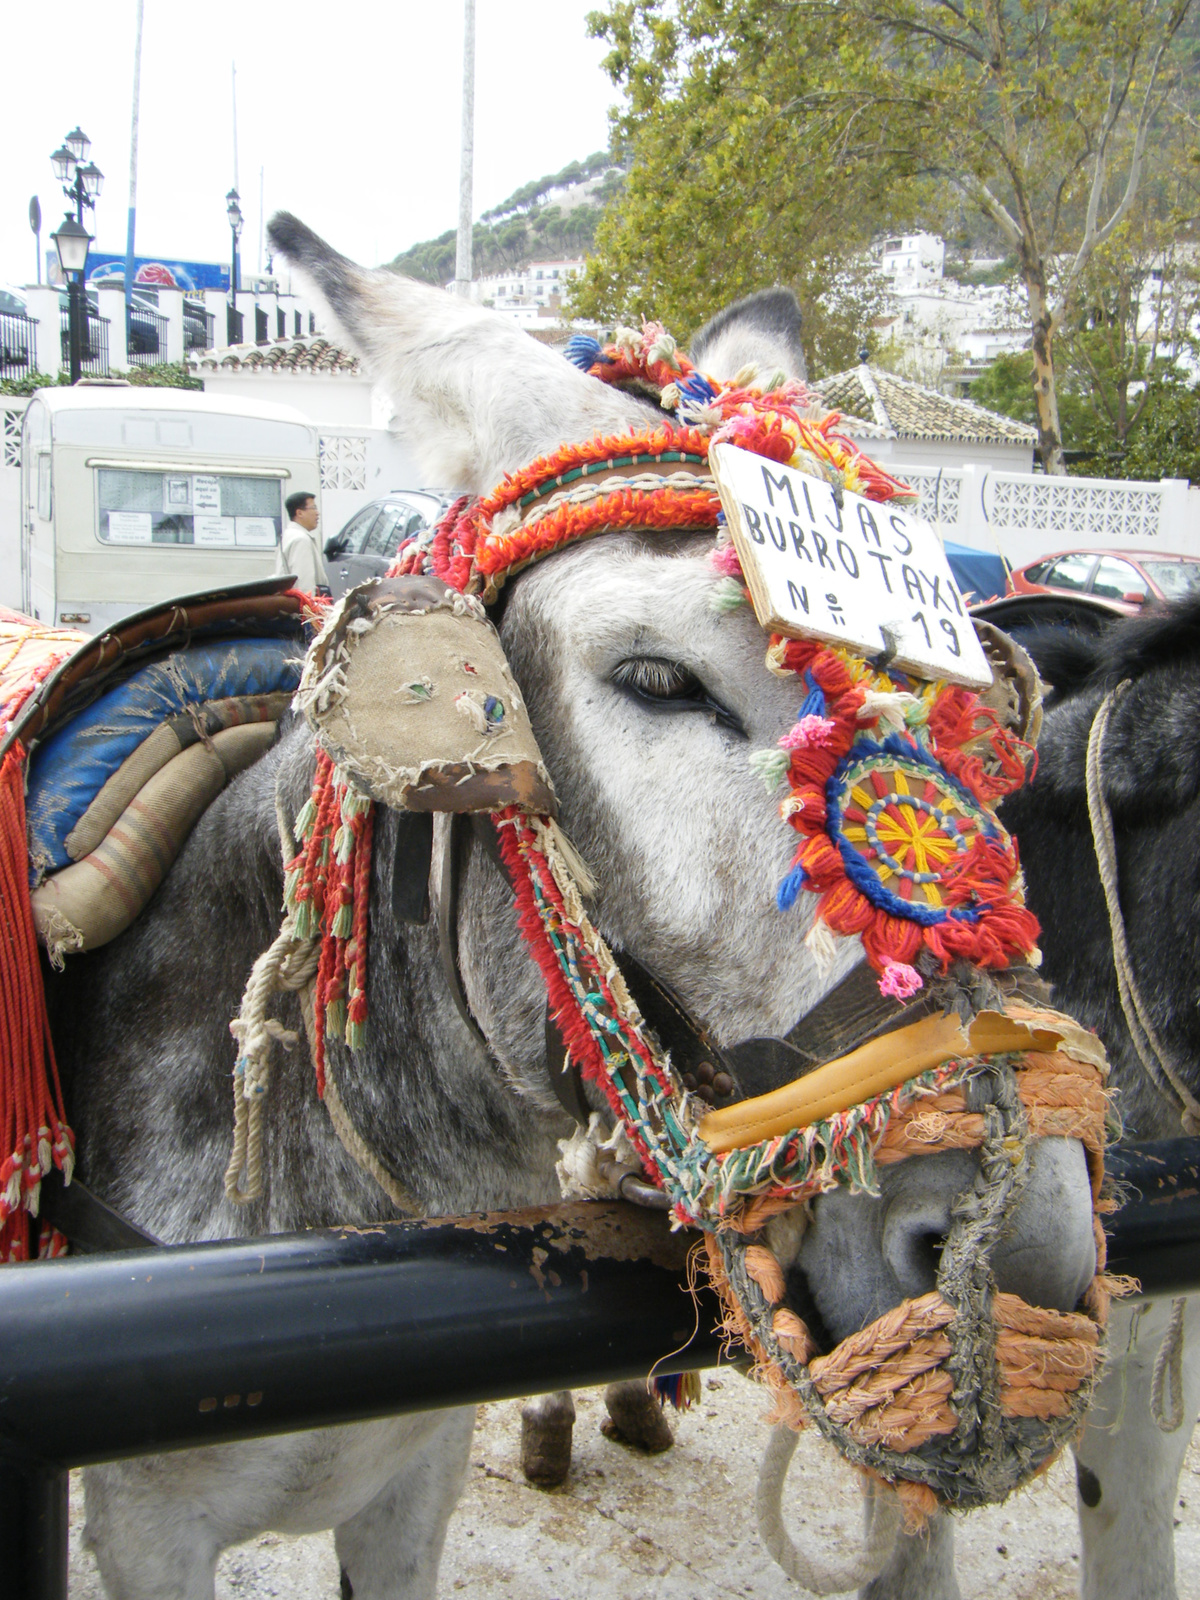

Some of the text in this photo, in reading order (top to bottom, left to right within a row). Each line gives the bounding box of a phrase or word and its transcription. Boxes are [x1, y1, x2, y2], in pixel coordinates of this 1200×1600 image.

[761, 465, 912, 556] MIJAS
[742, 503, 963, 617] BURRO TAXI
[912, 612, 961, 657] 19
